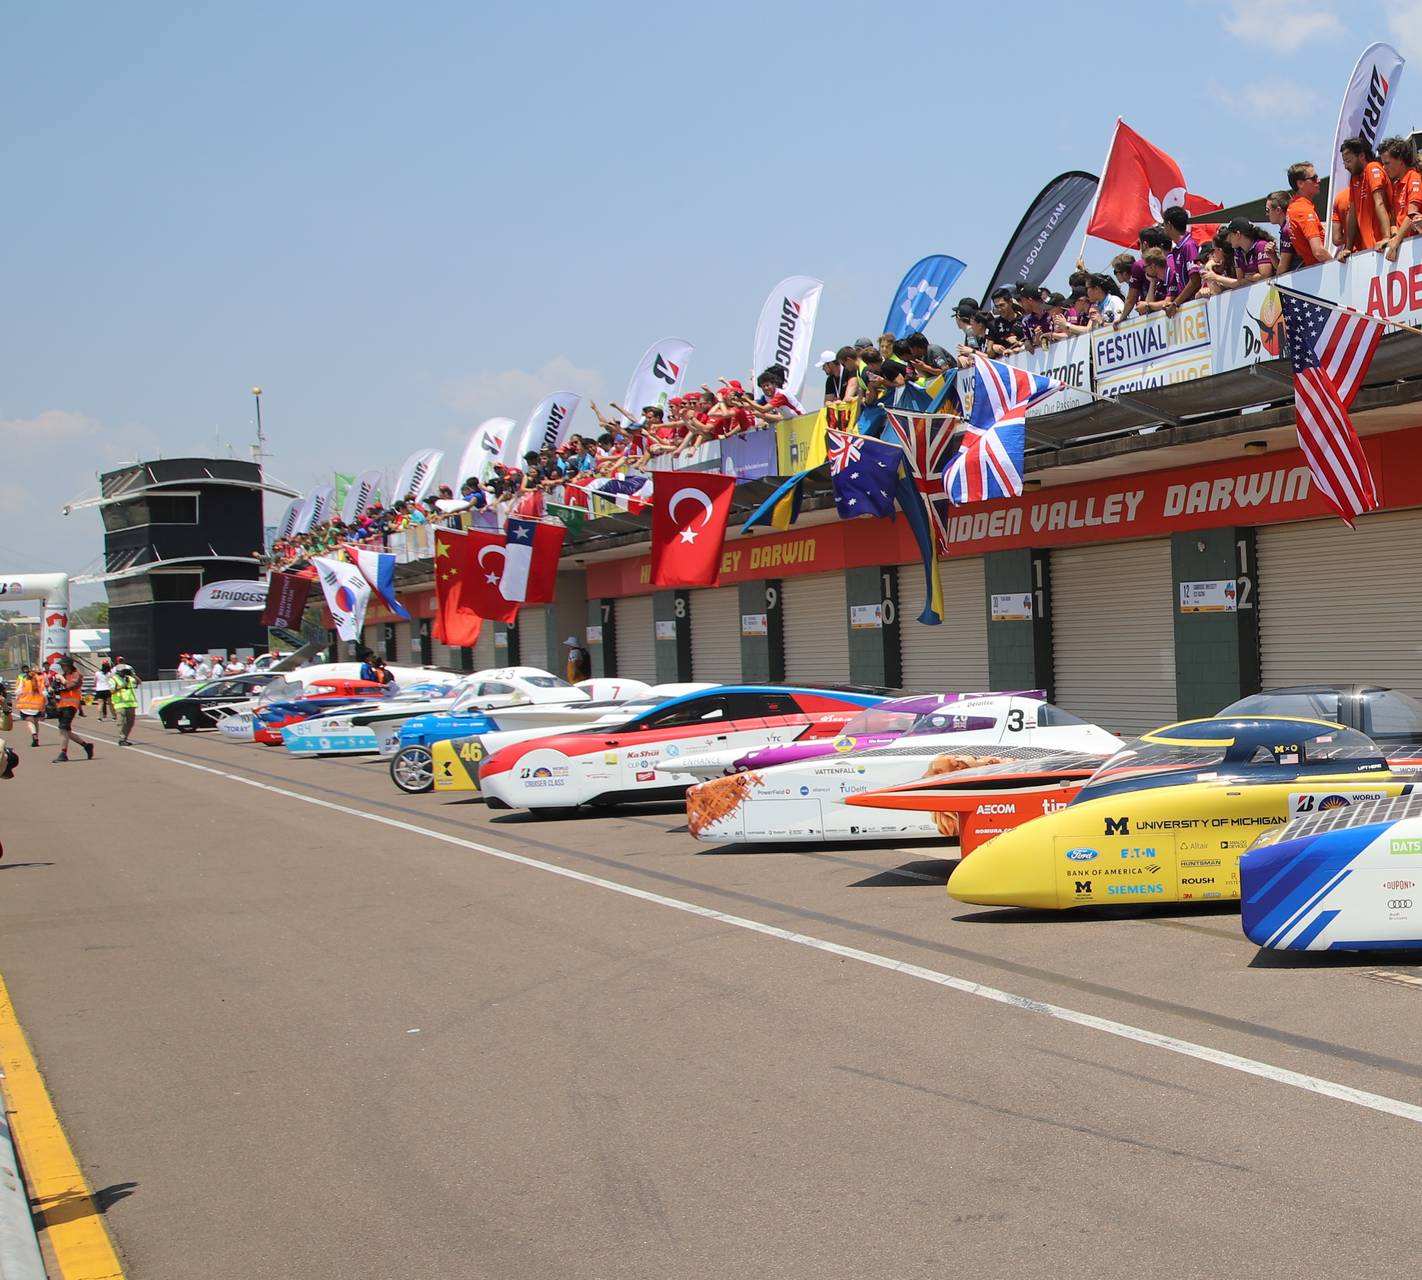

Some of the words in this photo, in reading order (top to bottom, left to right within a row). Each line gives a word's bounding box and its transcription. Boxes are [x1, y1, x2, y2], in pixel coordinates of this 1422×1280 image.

[1019, 263, 1030, 281] JU
[1027, 231, 1050, 266] SOLAR
[1045, 202, 1067, 232] TEAM
[1056, 398, 1080, 411] Passion
[1030, 489, 1145, 534] VALLEY
[1162, 465, 1311, 518] DARWIN
[750, 538, 817, 570] DARWIN
[766, 587, 777, 610] 9
[601, 605, 611, 623] 7
[675, 597, 686, 618] 8
[611, 685, 621, 700] 7
[967, 699, 994, 708] Deloitte
[1007, 708, 1024, 732] 3
[459, 742, 482, 762] 46
[814, 764, 856, 776] VATTENFALL
[524, 779, 547, 788] CRUISER
[547, 778, 565, 787] CLASS
[976, 803, 1016, 815] AECOM
[1104, 817, 1130, 836] M
[1136, 818, 1210, 830] UNIVERSITY
[1211, 817, 1229, 827] OF
[1230, 815, 1287, 827] MICHIGAN
[1392, 841, 1421, 851] DATS
[1070, 849, 1094, 861] Ford
[1066, 869, 1090, 877] BANK
[1091, 868, 1102, 876] OF
[1104, 867, 1143, 876] AMERICA
[1181, 877, 1215, 885] ROUSH
[1386, 880, 1413, 890] DUPONT
[1107, 883, 1164, 896] SIEMENS
